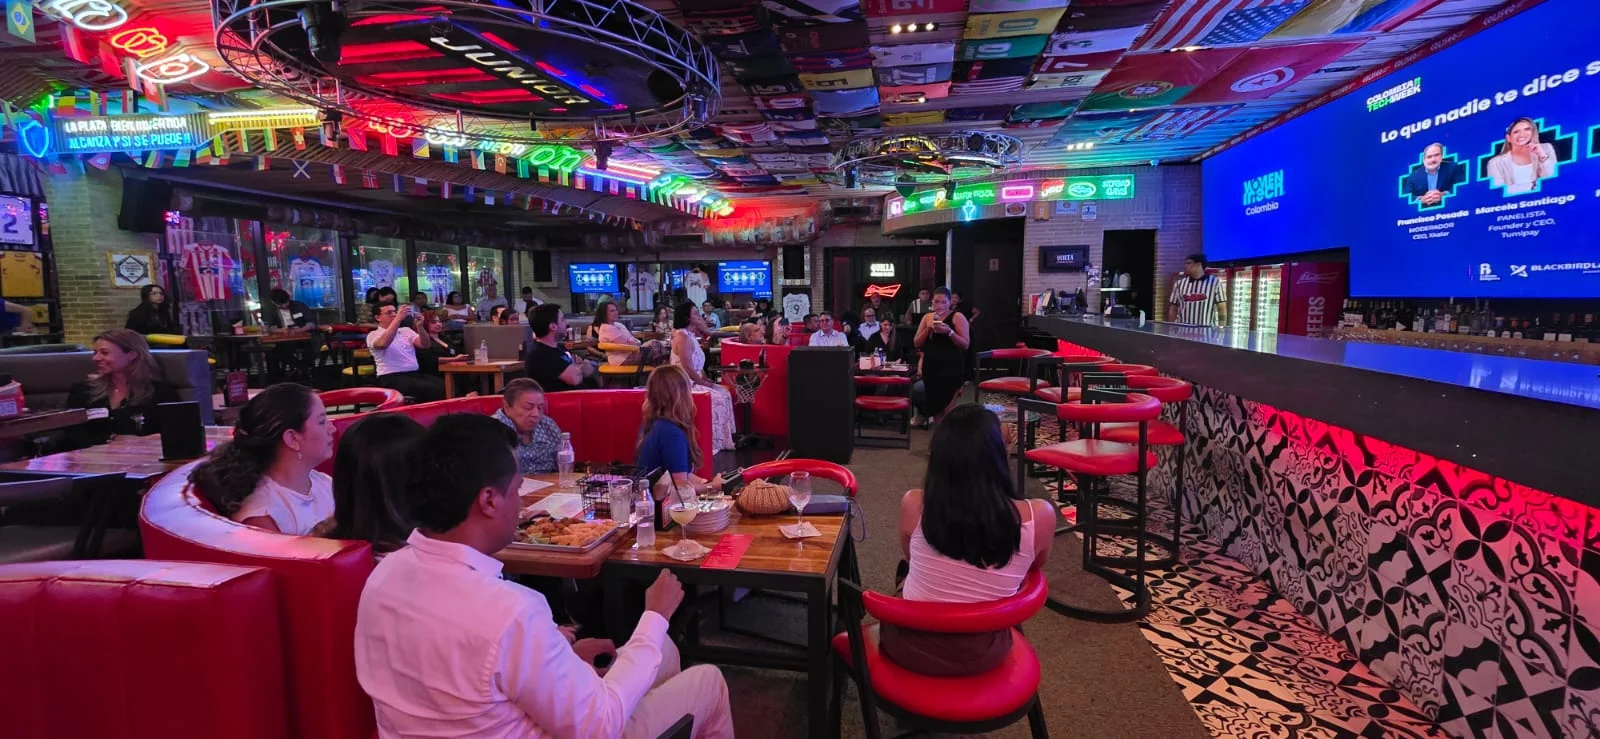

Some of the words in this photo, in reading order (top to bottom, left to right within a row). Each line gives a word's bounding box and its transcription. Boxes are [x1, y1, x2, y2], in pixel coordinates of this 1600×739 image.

[430, 36, 591, 105] JUNIOR
[1366, 79, 1414, 105] COLOMBIA
[1381, 129, 1399, 143] Lo
[1399, 117, 1432, 140] que
[1434, 97, 1491, 126] nadie
[1494, 88, 1519, 106] te
[1522, 67, 1581, 97] dice
[65, 121, 78, 133] LA
[78, 119, 108, 132] PLATA
[112, 135, 121, 147] Y
[121, 135, 131, 147] SI
[134, 134, 149, 147] SE
[150, 132, 182, 145] PUEDE
[479, 140, 526, 155] NEON
[1245, 201, 1279, 216] Colombia
[1475, 203, 1518, 215] Marcela
[1519, 194, 1576, 208] Santiago
[1397, 215, 1435, 227] Francisco
[1435, 209, 1469, 221] Posada
[1496, 210, 1547, 222] PANELISTA
[1488, 222, 1524, 232] Founder
[1525, 221, 1532, 229] y
